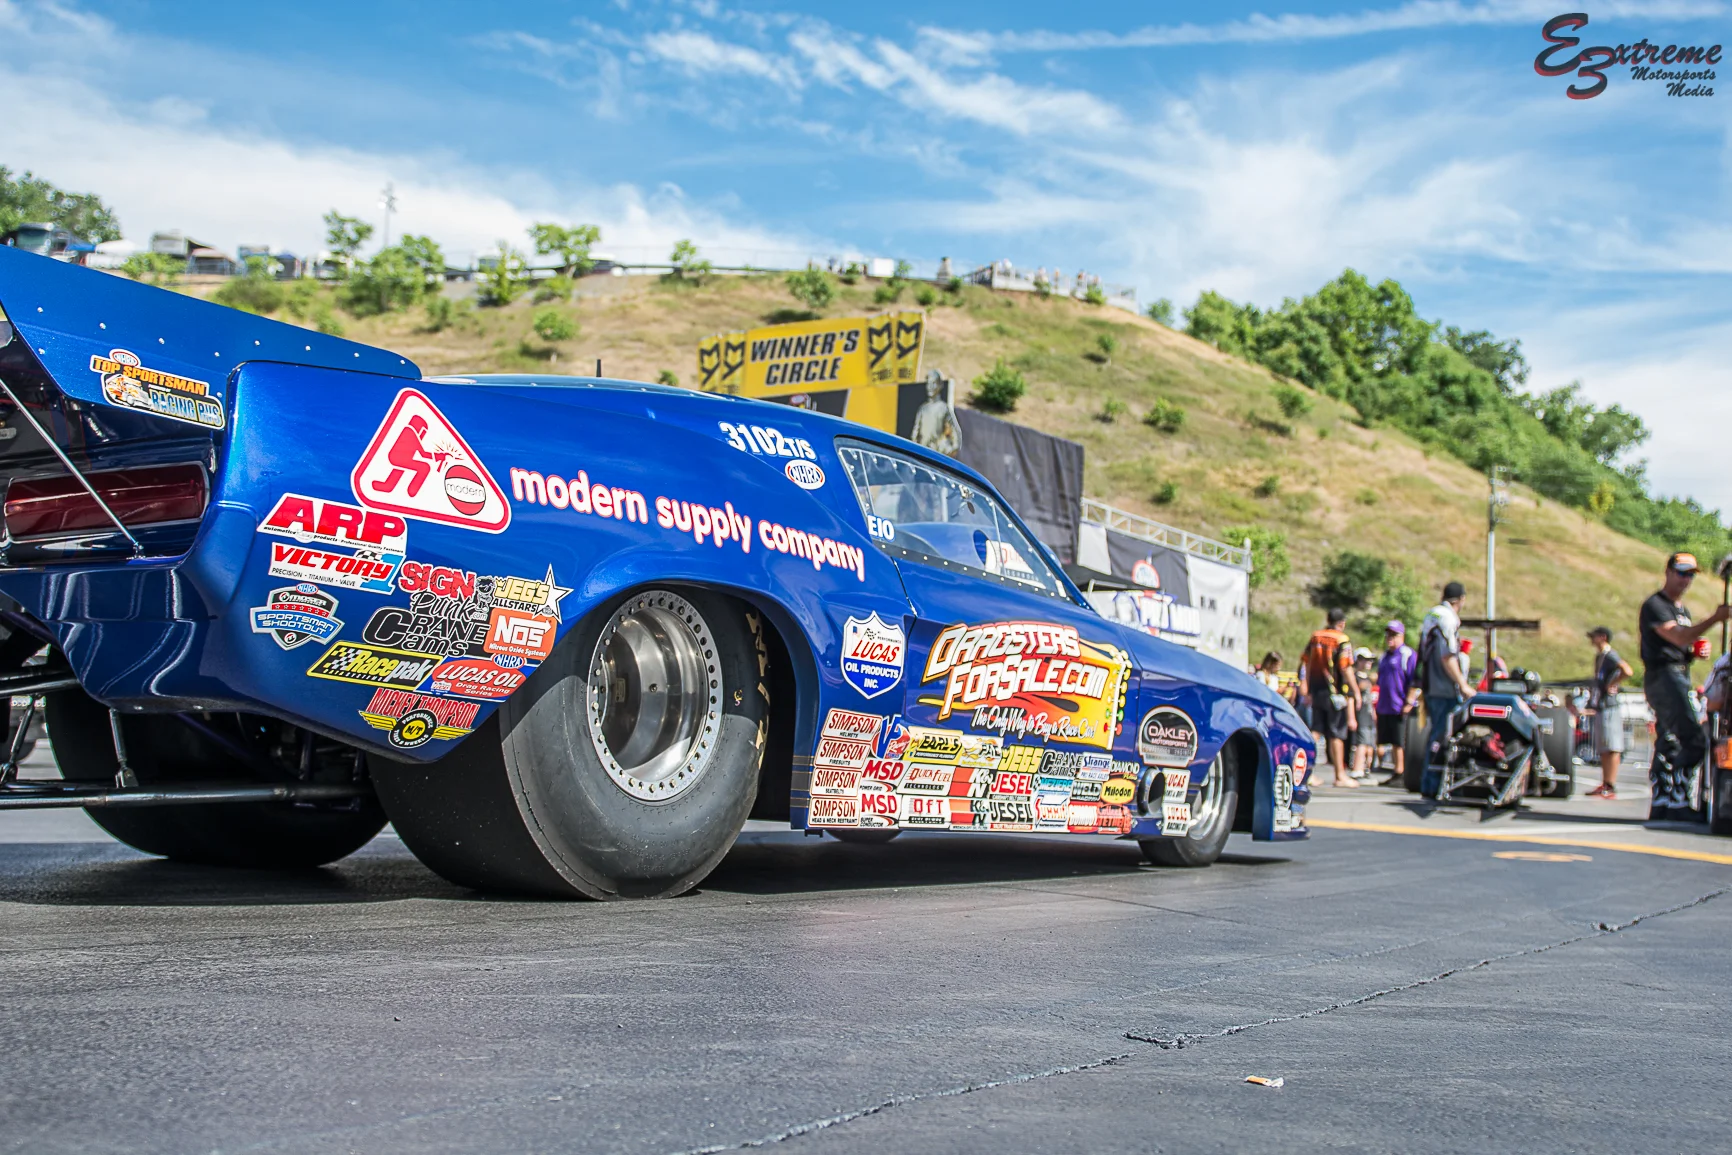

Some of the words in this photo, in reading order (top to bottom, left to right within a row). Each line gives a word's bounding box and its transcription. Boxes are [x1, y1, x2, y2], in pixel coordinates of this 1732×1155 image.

[750, 329, 860, 363] WINNER'S
[93, 357, 120, 374] TOP
[122, 365, 206, 395] SPORTSMAN
[764, 356, 842, 387] CIRCLE
[149, 389, 198, 421] RACING
[788, 462, 823, 487] NHRA
[446, 482, 485, 498] modern
[265, 496, 406, 544] ARP
[510, 467, 648, 525] modern
[656, 496, 752, 553] supply
[758, 519, 865, 582] company
[275, 545, 394, 579] VICTORY
[272, 567, 303, 578] PRECISION
[308, 573, 334, 584] TITANIUM
[339, 578, 356, 587] VALVE
[399, 561, 476, 599] SIGN
[494, 577, 551, 605] JEG'S
[411, 590, 475, 623] Punk
[492, 599, 539, 613] ALLSTARS
[658, 591, 673, 600] PRO
[674, 596, 698, 618] SERIES
[257, 613, 334, 632] SPORTSMAN
[262, 619, 327, 635] SHOOTOUT
[494, 614, 547, 649] NOS
[488, 642, 509, 653] Nitrous
[508, 646, 525, 655] Oxide
[524, 648, 547, 658] Systems
[851, 640, 900, 663] LUCAS
[925, 624, 1081, 683] DRAGSTERS
[346, 650, 433, 682] Racepak
[496, 655, 523, 668] NHRA
[845, 661, 859, 673] OIL
[860, 664, 899, 679] PRODUCTS
[437, 665, 498, 684] LUCAS
[494, 672, 522, 688] OIL
[863, 677, 879, 689] INC.
[455, 682, 478, 690] Drag
[479, 685, 511, 694] Racing
[464, 688, 493, 697] Series
[366, 687, 419, 718] MICKEY
[415, 694, 481, 729] THOMPSON
[404, 725, 424, 736] M/T
[829, 712, 879, 734] SIMPSON
[971, 704, 988, 727] The
[987, 705, 1008, 737] Only
[1007, 707, 1027, 740] Way
[1034, 711, 1052, 742] Buy
[1057, 715, 1079, 742] Race
[1148, 725, 1194, 741] OAKLEY
[840, 731, 859, 739] HELMETS
[876, 714, 903, 759] VP
[919, 735, 959, 752] EARL'S
[1151, 738, 1188, 748] MOTORSPORTS
[819, 741, 866, 761] SIMPSON
[997, 745, 1045, 774] JEGS
[828, 758, 851, 766] FIRESUITS
[862, 760, 904, 781] MSD
[1039, 751, 1083, 775] CRANE
[1083, 755, 1110, 769] Strange
[1111, 761, 1140, 774] DIAMOND
[815, 769, 858, 789] SIMPSON
[990, 773, 1032, 795] JESEL
[1073, 781, 1102, 796] WELD
[1104, 786, 1132, 797] Milodon
[813, 799, 856, 817] SIMPSON
[861, 793, 898, 814] MSD
[989, 801, 1034, 823] JESEL
